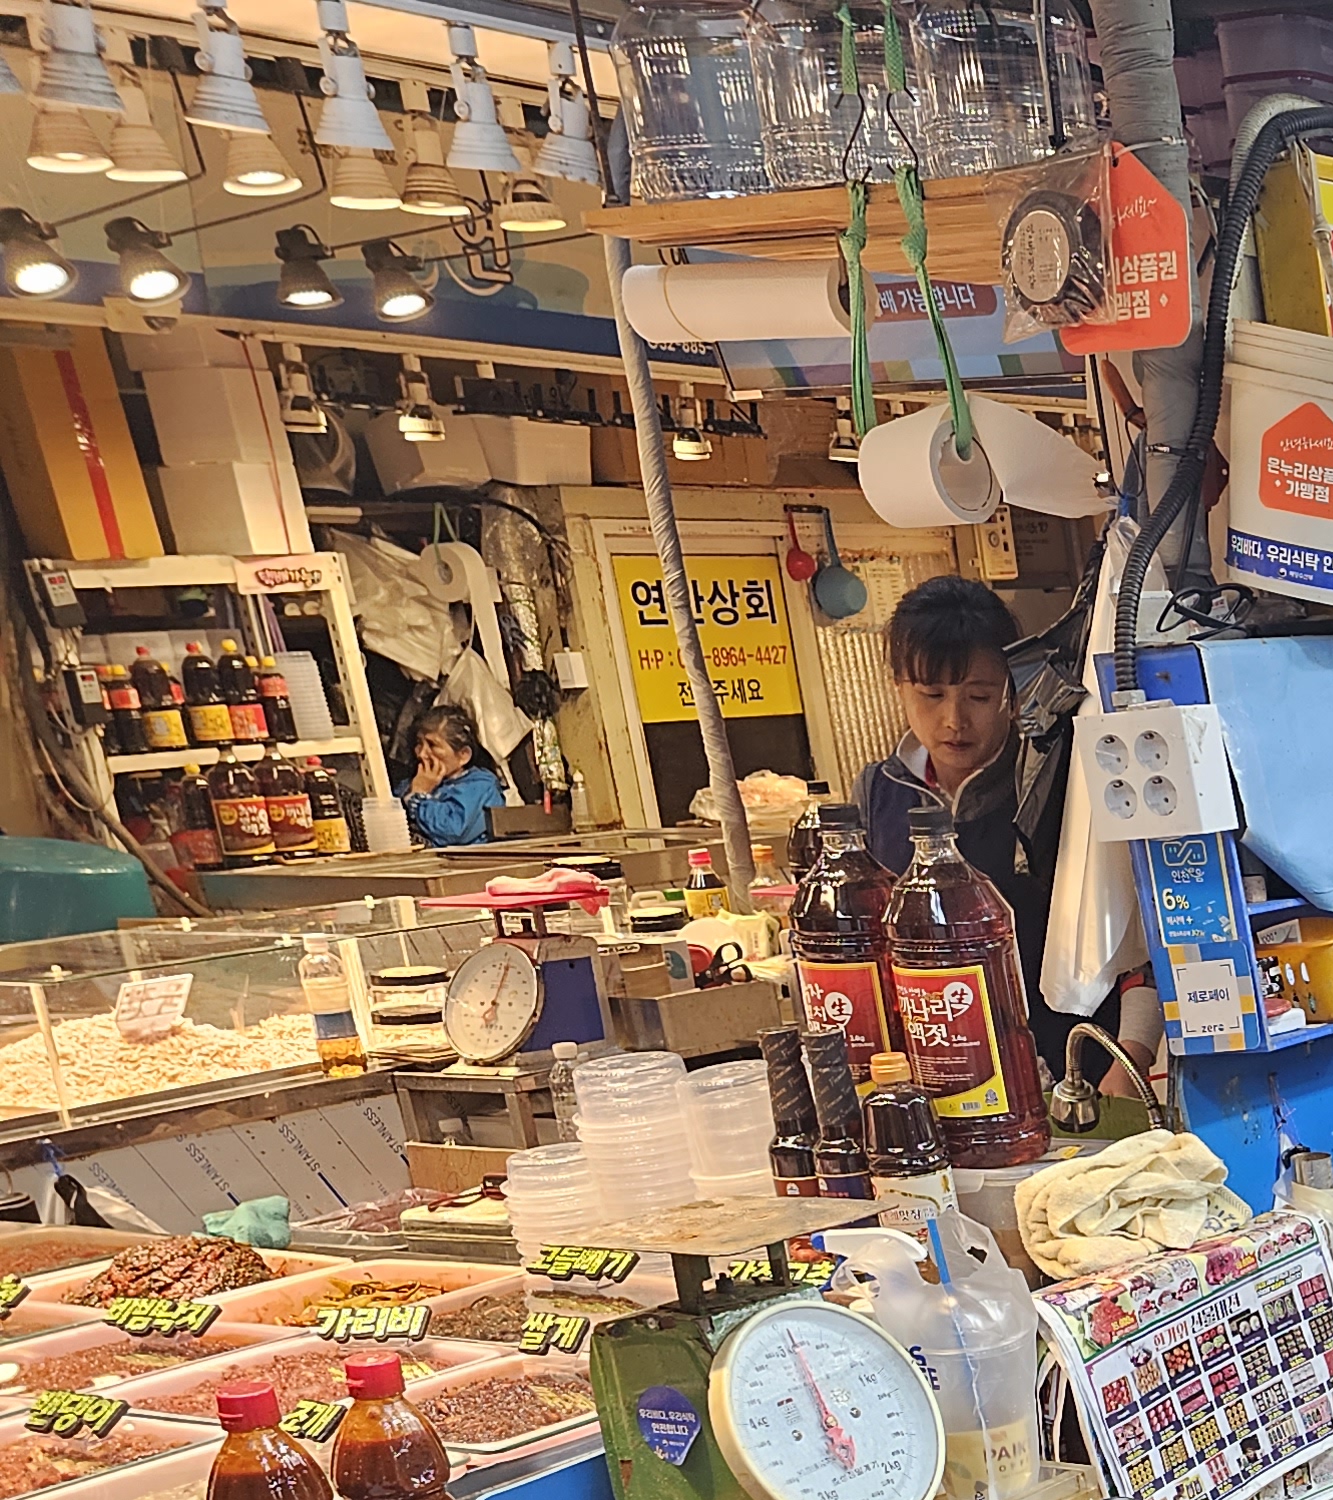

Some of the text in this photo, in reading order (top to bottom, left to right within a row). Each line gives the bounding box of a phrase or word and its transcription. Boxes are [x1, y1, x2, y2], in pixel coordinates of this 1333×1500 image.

[1285, 479, 1330, 504] 가맹점
[1266, 544, 1321, 571] 우리식탁
[677, 678, 764, 707] 전주세요
[1162, 888, 1190, 911] 6%
[1186, 987, 1231, 1004] 제로페이
[908, 1023, 951, 1048] 액젓
[1201, 1022, 1226, 1036] zero
[361, 1106, 405, 1155] STAINLESS
[278, 1123, 321, 1173] STAINLESS
[186, 1142, 231, 1192] STAINLESS
[315, 1305, 428, 1338] 가리비
